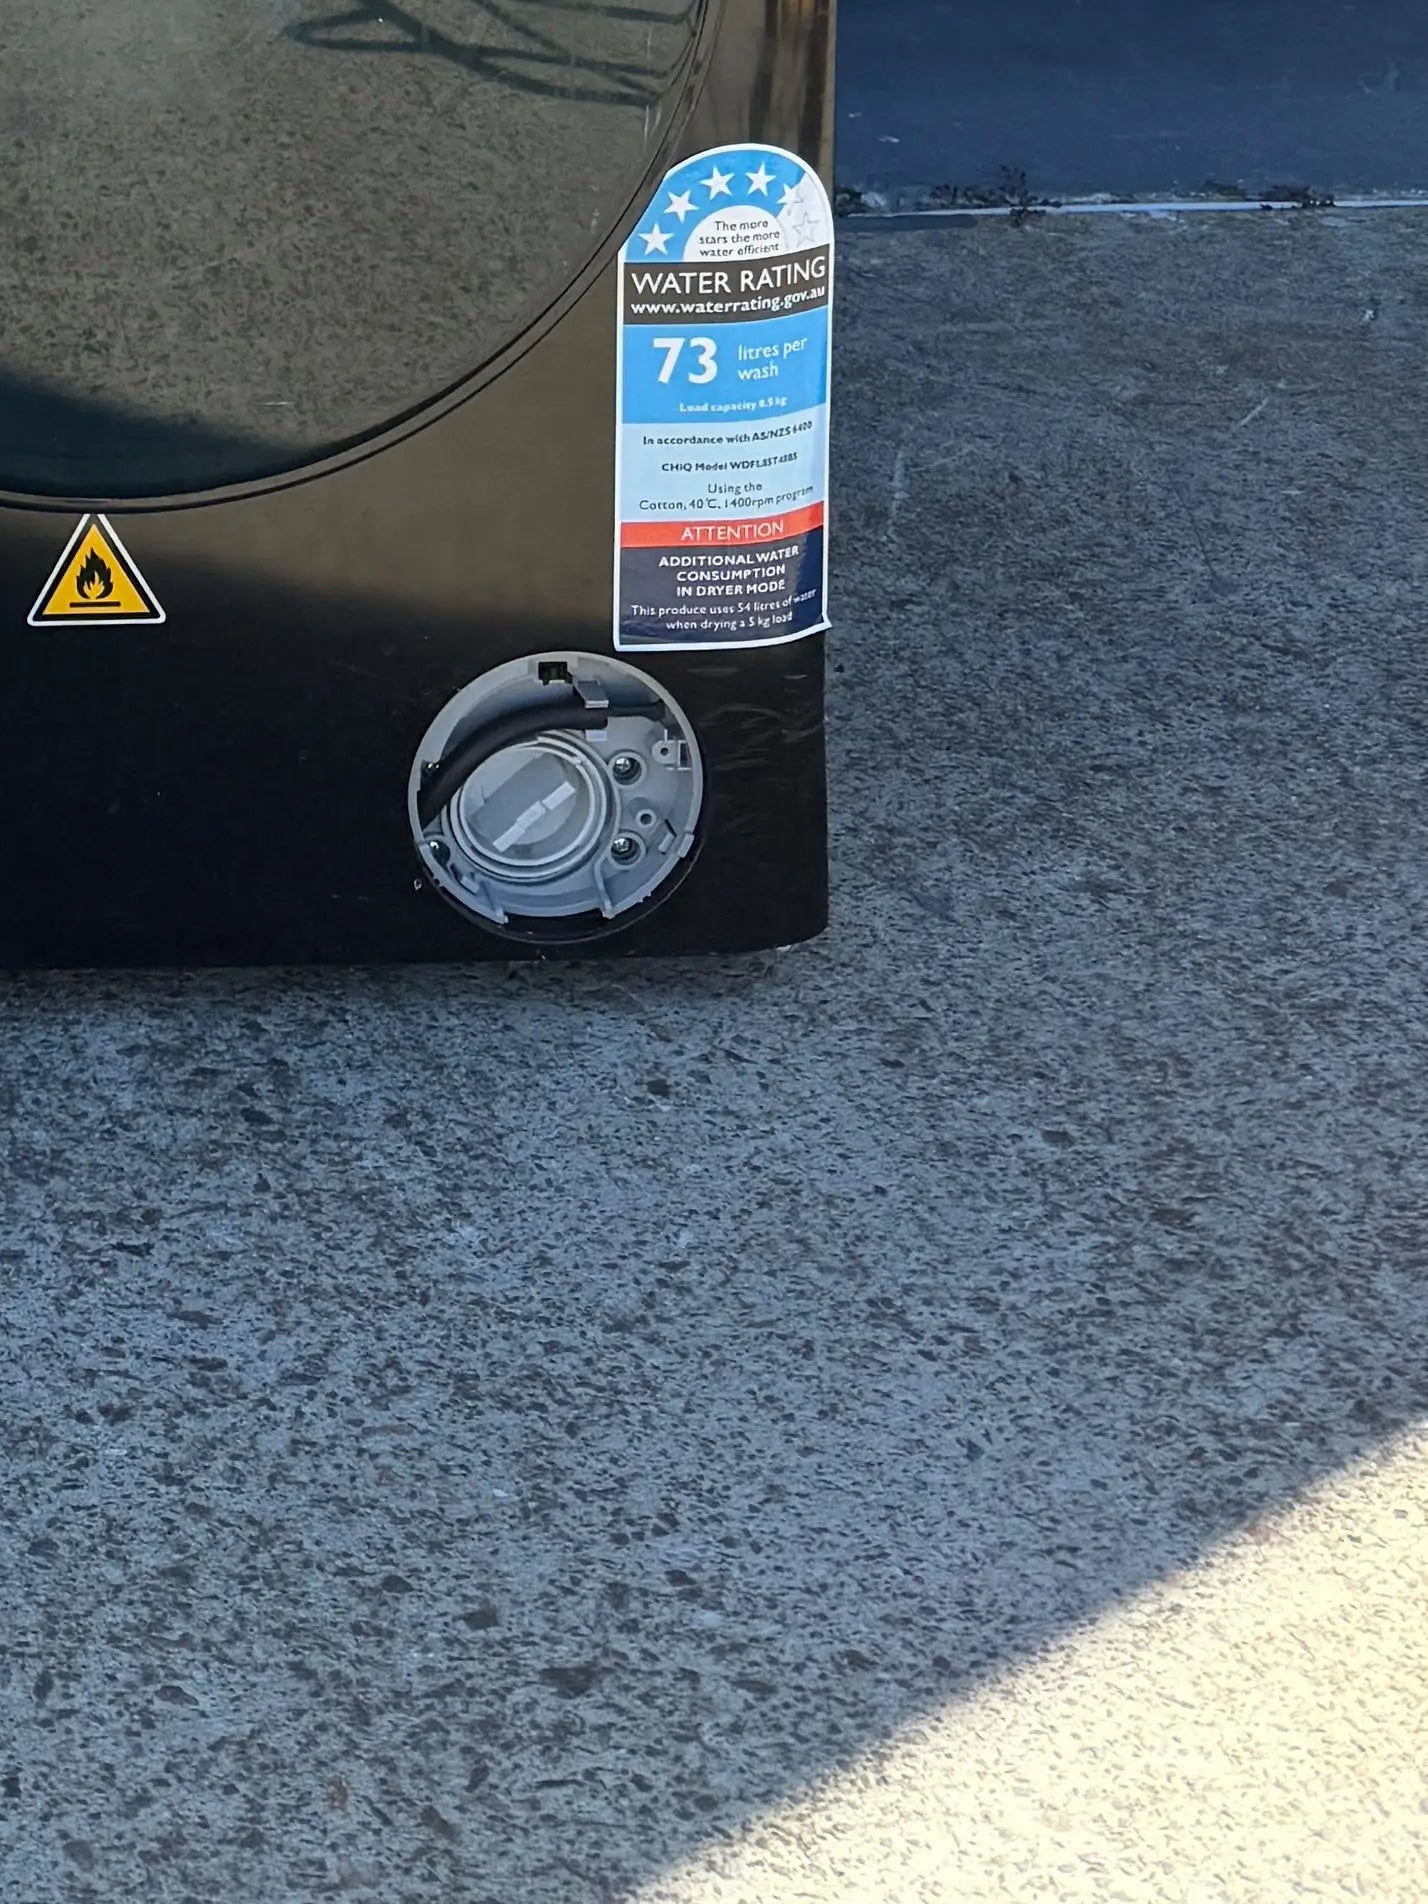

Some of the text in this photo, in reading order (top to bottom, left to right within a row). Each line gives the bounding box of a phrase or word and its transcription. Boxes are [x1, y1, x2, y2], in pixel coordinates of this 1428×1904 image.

[715, 220, 768, 231] The more
[699, 231, 780, 245] stars the more
[700, 243, 779, 256] water efficient
[631, 255, 826, 294] WATER RATING
[631, 285, 825, 314] www.waterrating.gov.au
[738, 336, 808, 361] litres per
[653, 336, 718, 384] 73
[738, 361, 779, 381] wash
[643, 436, 654, 445] In
[657, 435, 723, 445] accordance
[726, 434, 750, 444] with
[752, 428, 791, 442] AS/NZS
[695, 460, 727, 471] Model
[639, 500, 687, 511] Cotton,
[724, 497, 774, 508] 1400rpm
[776, 486, 814, 504] program
[708, 482, 762, 495] Using the
[681, 520, 784, 540] ATTENTION
[659, 546, 799, 568] ADDITIONAL WATER
[677, 564, 786, 581] CONSUMPTION
[677, 579, 785, 597] IN DRYER MODE
[666, 619, 697, 629] when
[700, 618, 737, 631] drying
[749, 617, 755, 627] 5
[757, 616, 771, 628] kg
[772, 611, 793, 624] load
